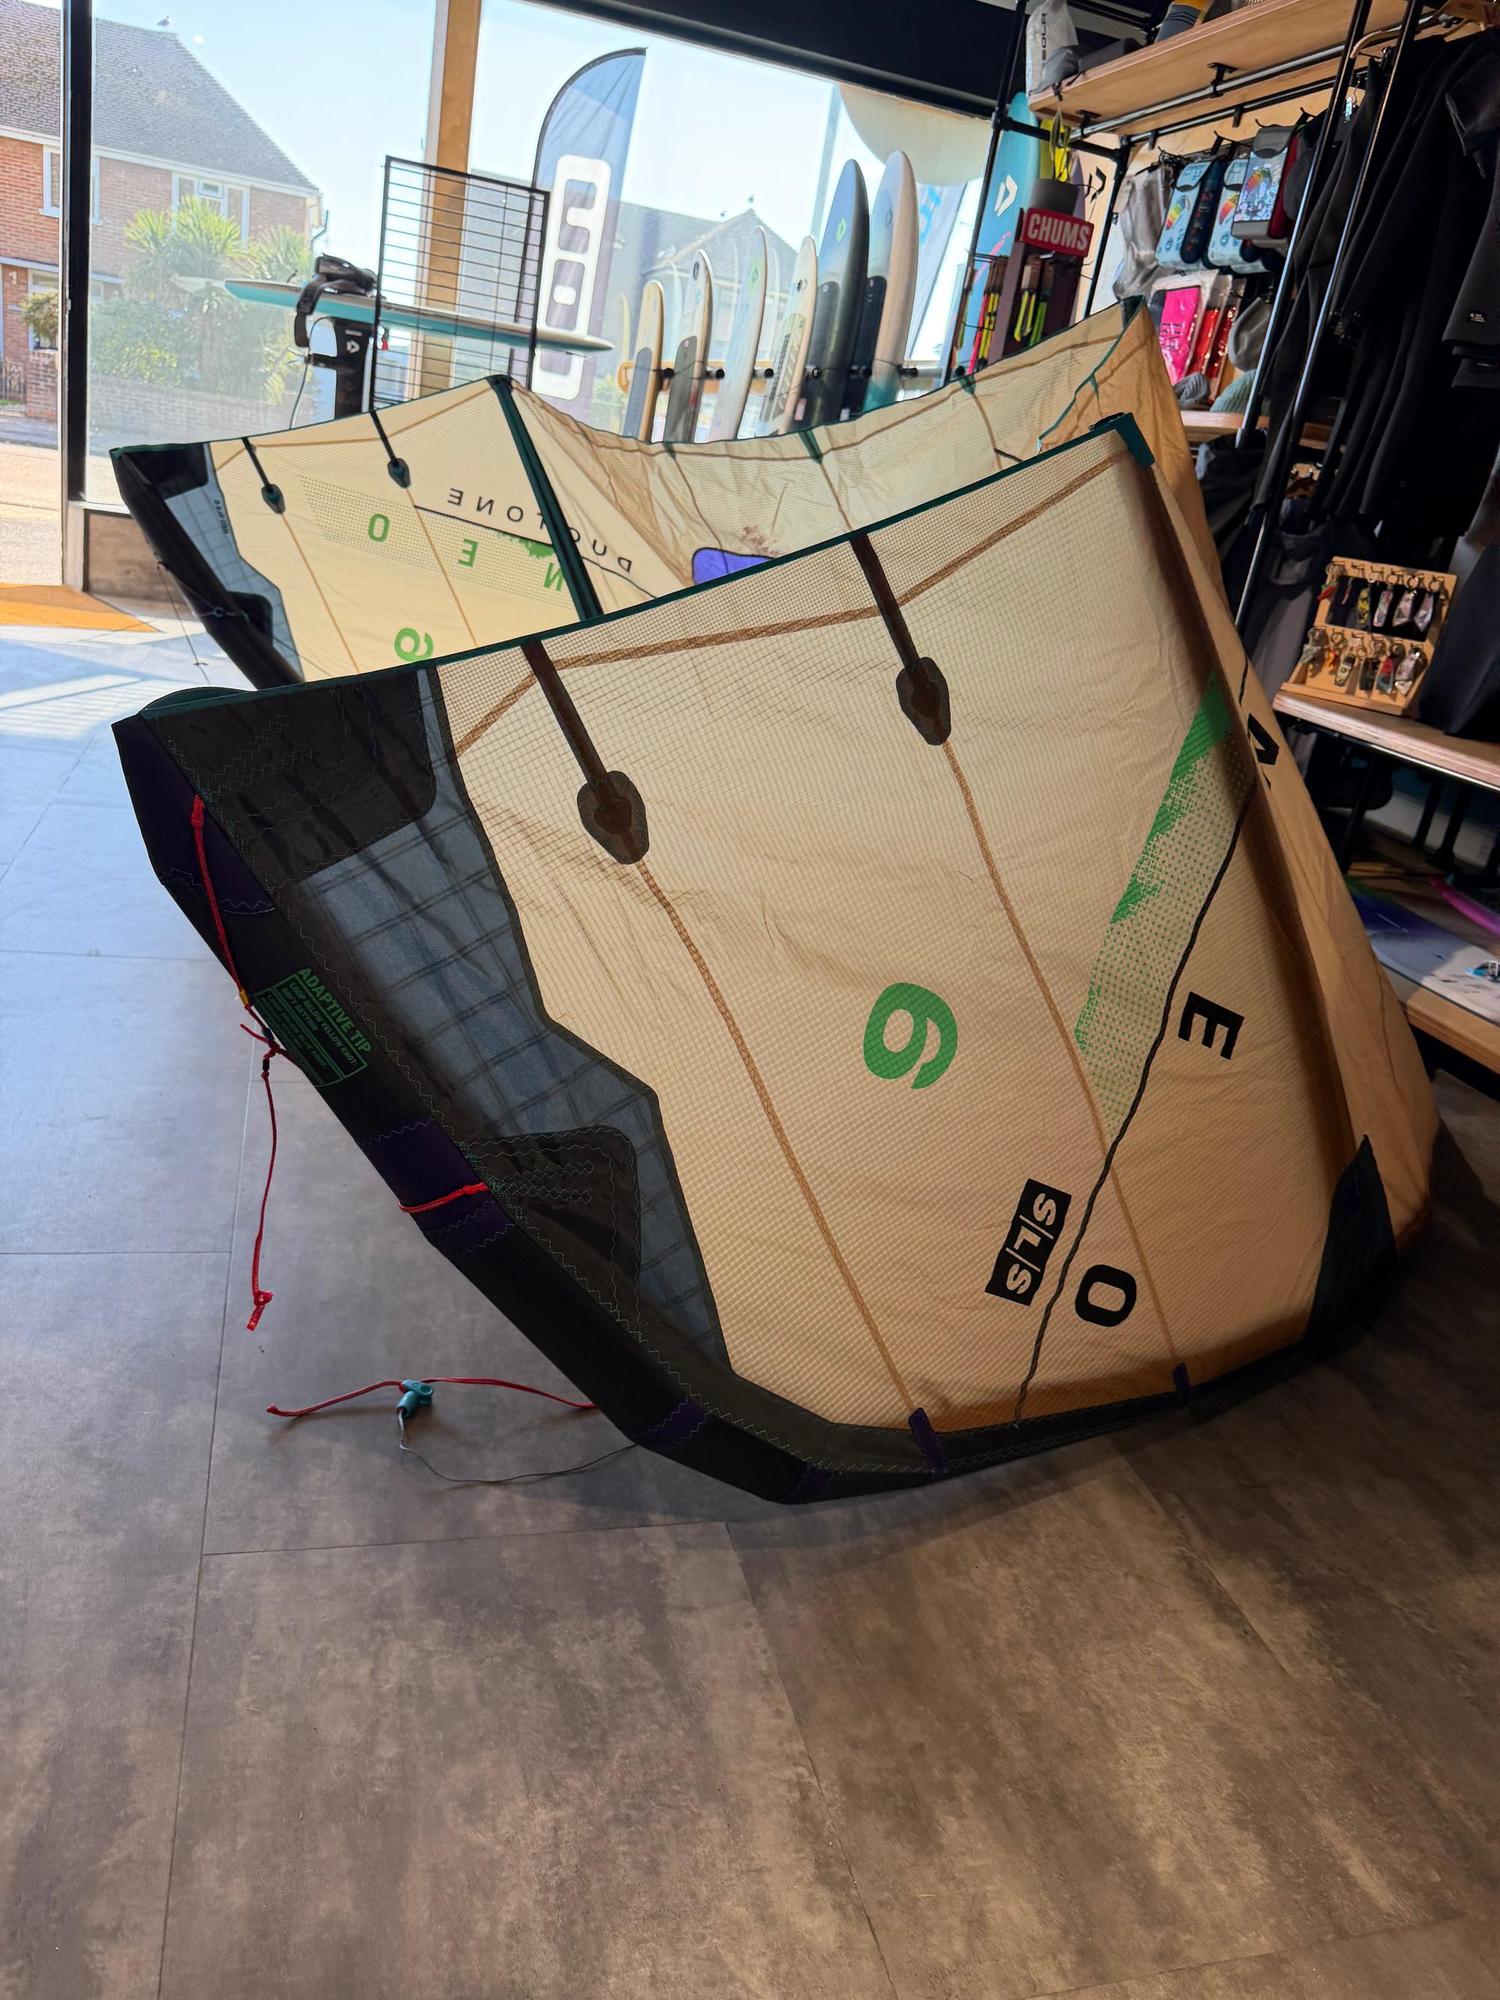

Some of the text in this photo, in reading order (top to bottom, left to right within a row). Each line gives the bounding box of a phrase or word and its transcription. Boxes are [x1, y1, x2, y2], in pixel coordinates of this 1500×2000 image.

[1027, 213, 1090, 251] CHUMS
[288, 983, 306, 999] LOOP
[320, 1022, 343, 1046] YELLOW
[298, 968, 372, 1053] ADAPTIVE TIP
